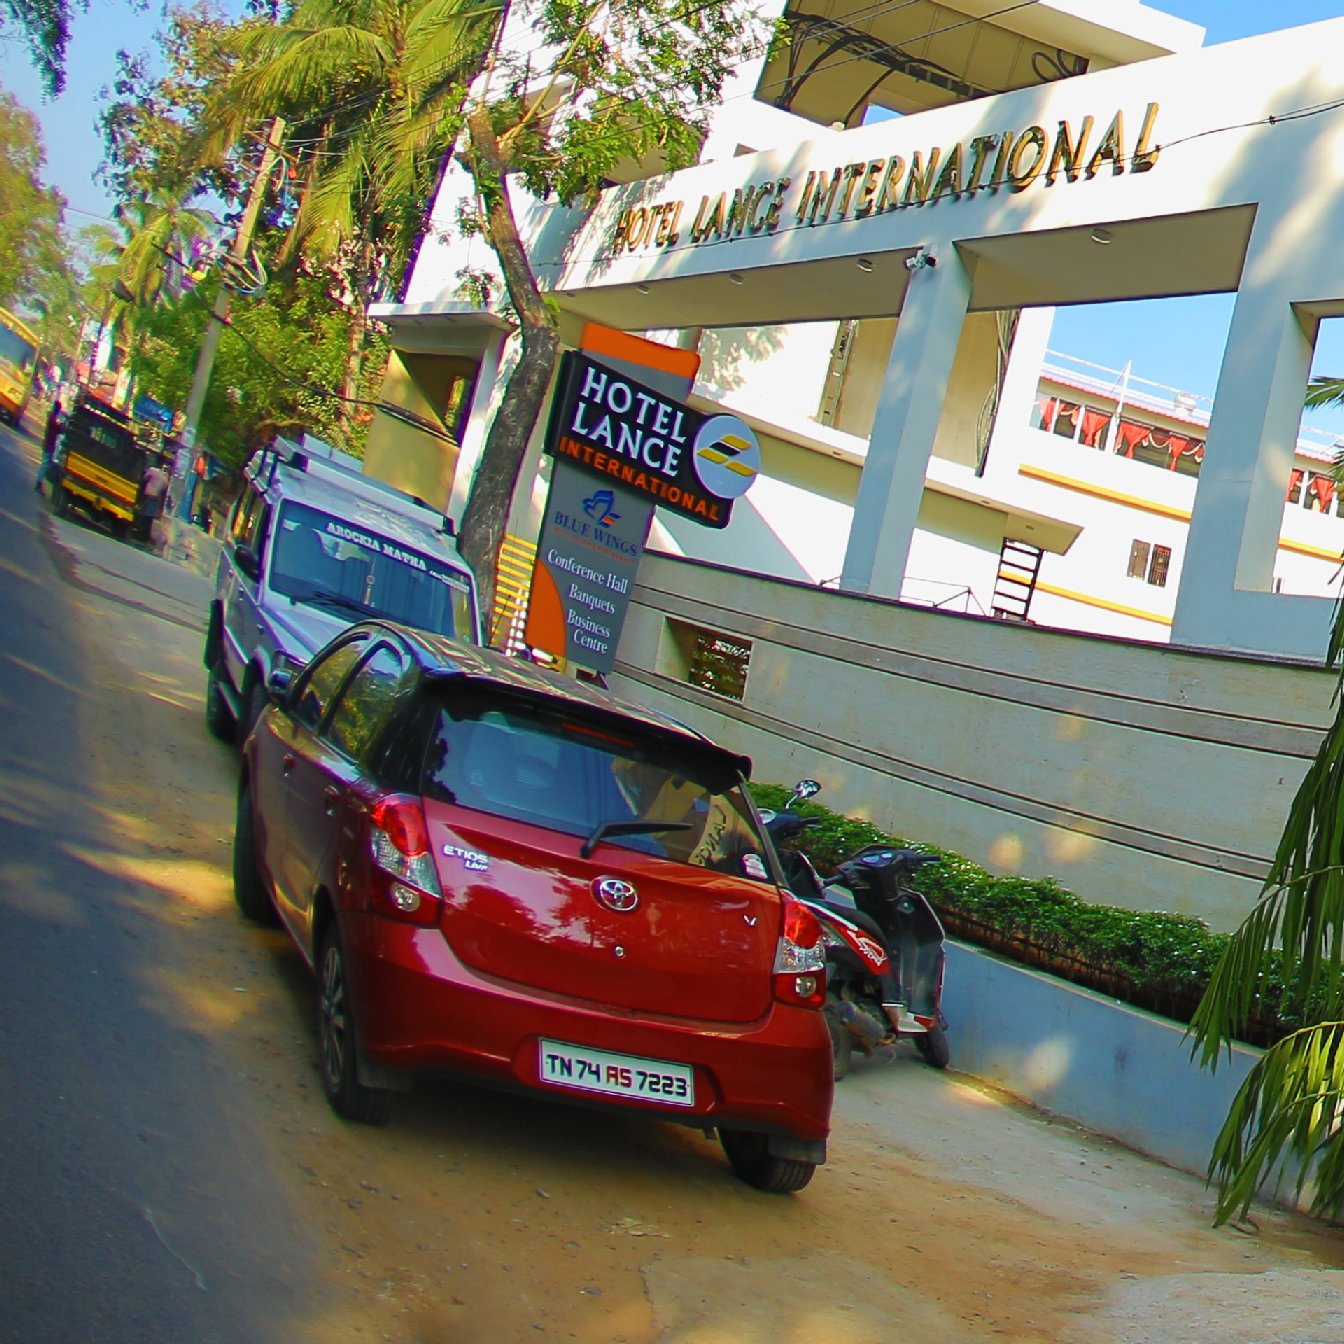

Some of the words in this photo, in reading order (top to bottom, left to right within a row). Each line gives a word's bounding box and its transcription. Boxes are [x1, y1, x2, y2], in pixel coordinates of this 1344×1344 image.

[613, 199, 684, 254] HOTEL
[690, 177, 792, 244] LANCE
[797, 102, 1159, 224] INTERNATIONAL
[580, 366, 687, 443] HOTEL
[571, 401, 682, 477] LANCE
[559, 436, 720, 522] INTERNATIONAL
[327, 522, 380, 552] AROCKIA
[382, 543, 427, 571] MATHA
[554, 511, 590, 538] BLUE
[594, 527, 638, 556] WINGS
[548, 548, 605, 585] Conference
[606, 573, 629, 594] Hall
[569, 583, 616, 614] Banquets
[567, 608, 611, 638] Business
[573, 628, 608, 654] Centre
[443, 844, 488, 864] ETIOS
[546, 1054, 572, 1077] TN
[576, 1059, 601, 1083] 74
[606, 1065, 632, 1088] AS
[635, 1071, 687, 1097] 7223
